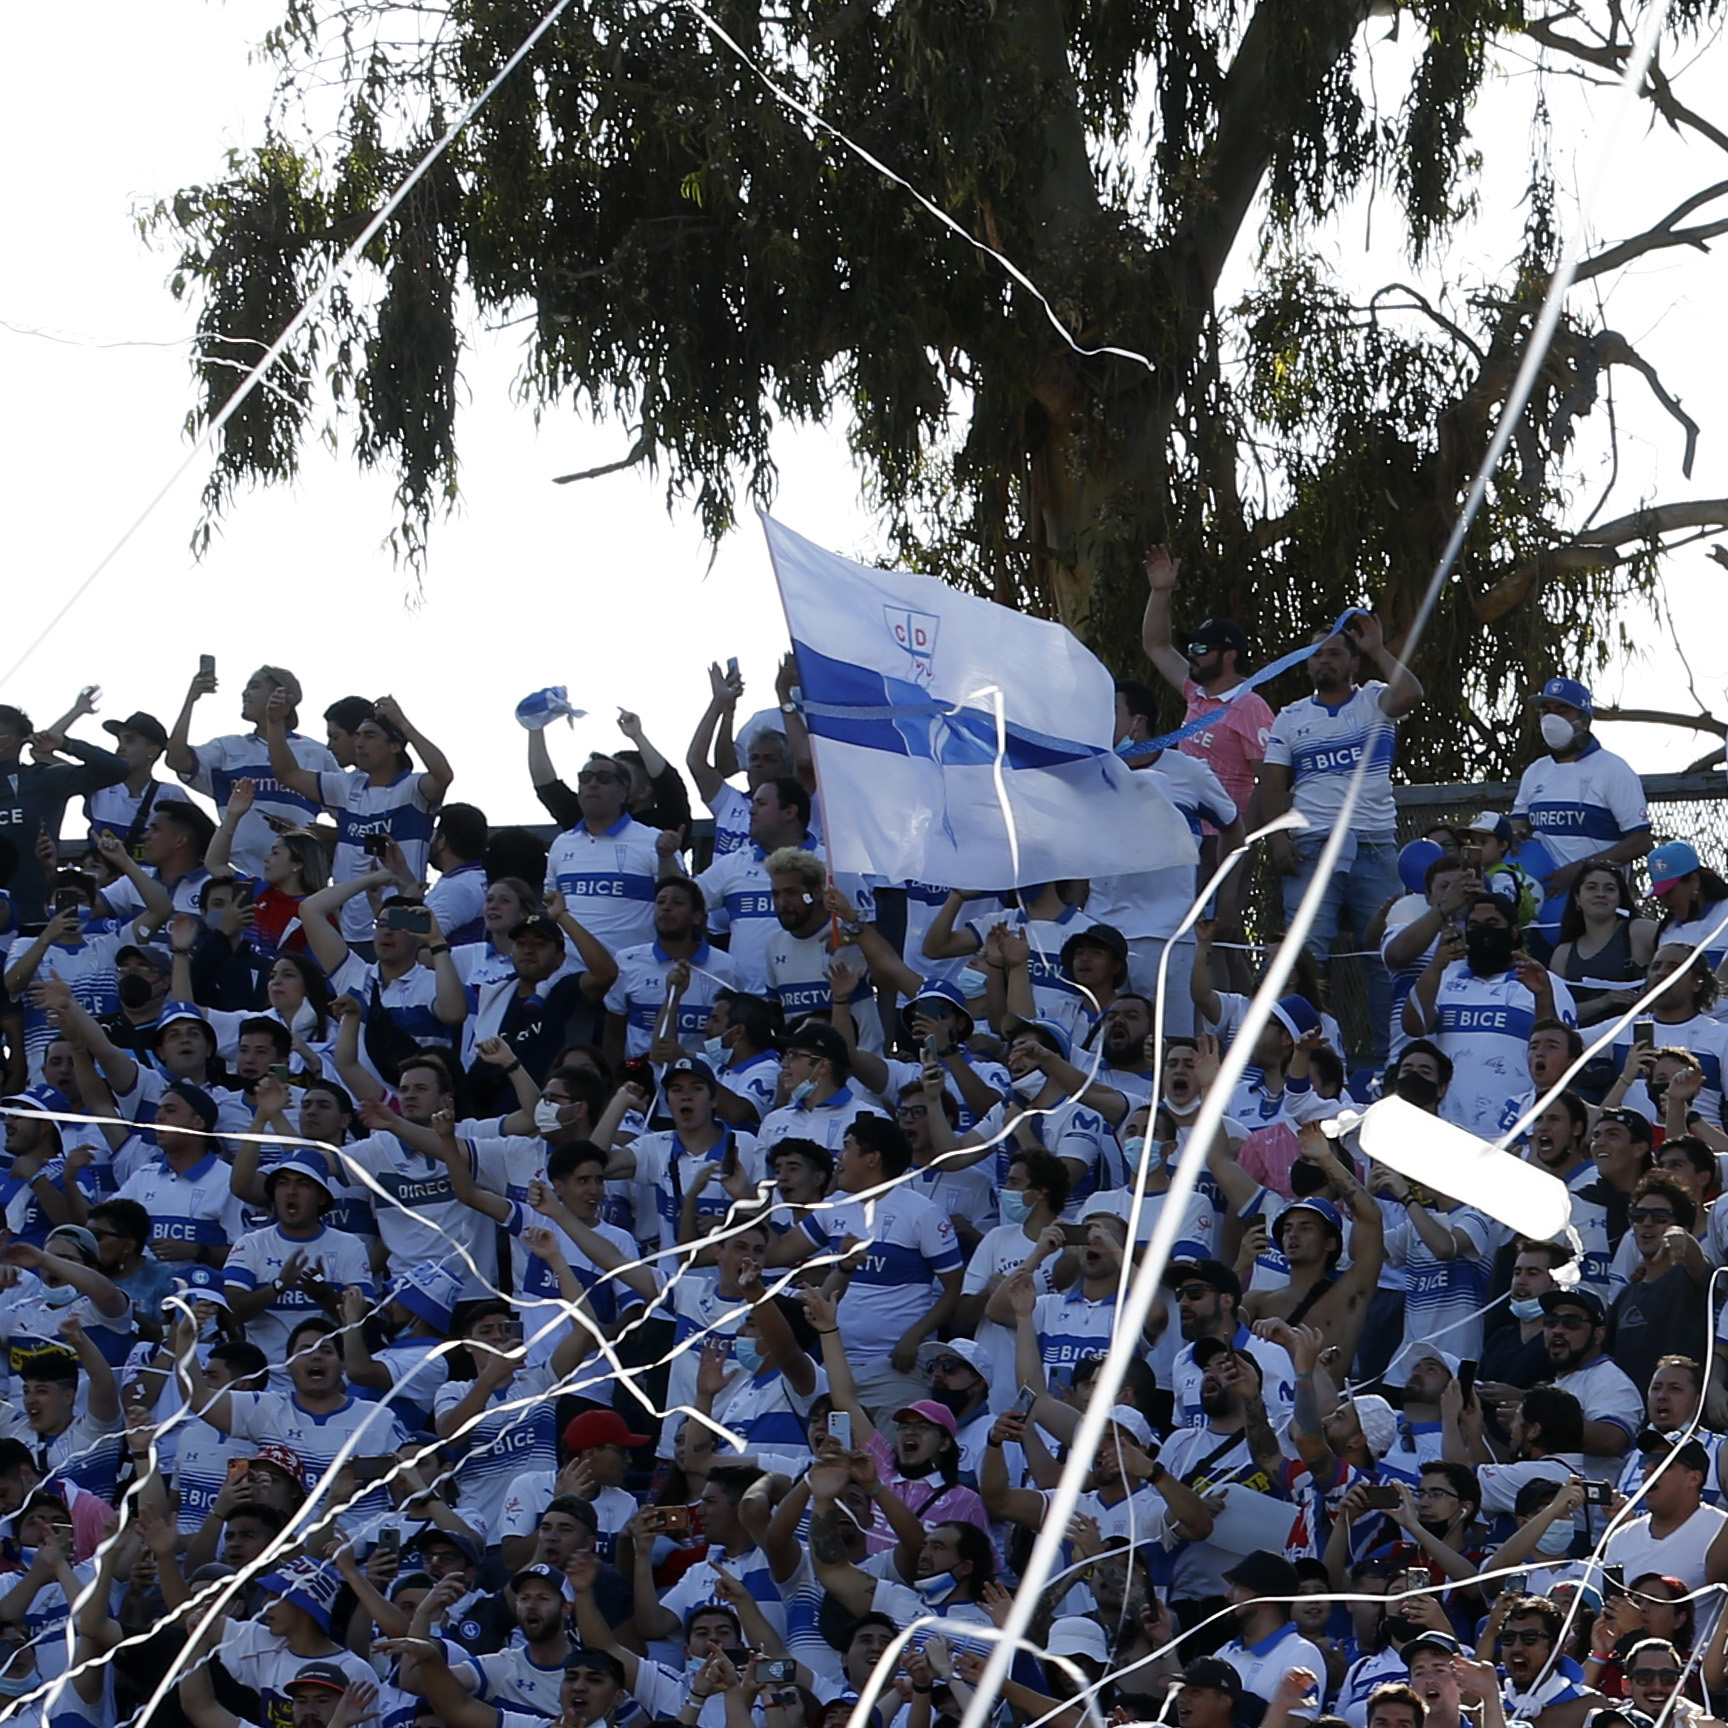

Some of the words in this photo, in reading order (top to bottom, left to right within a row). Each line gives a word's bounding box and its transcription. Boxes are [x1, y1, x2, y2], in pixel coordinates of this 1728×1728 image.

[894, 624, 906, 642] C
[915, 628, 926, 645] D
[1317, 746, 1361, 768] BICE
[1529, 810, 1585, 826] DIRECTV
[576, 881, 623, 895] BICE
[1459, 1011, 1507, 1026] BICE
[153, 1223, 196, 1240] BICE
[1417, 1270, 1448, 1291] BICE
